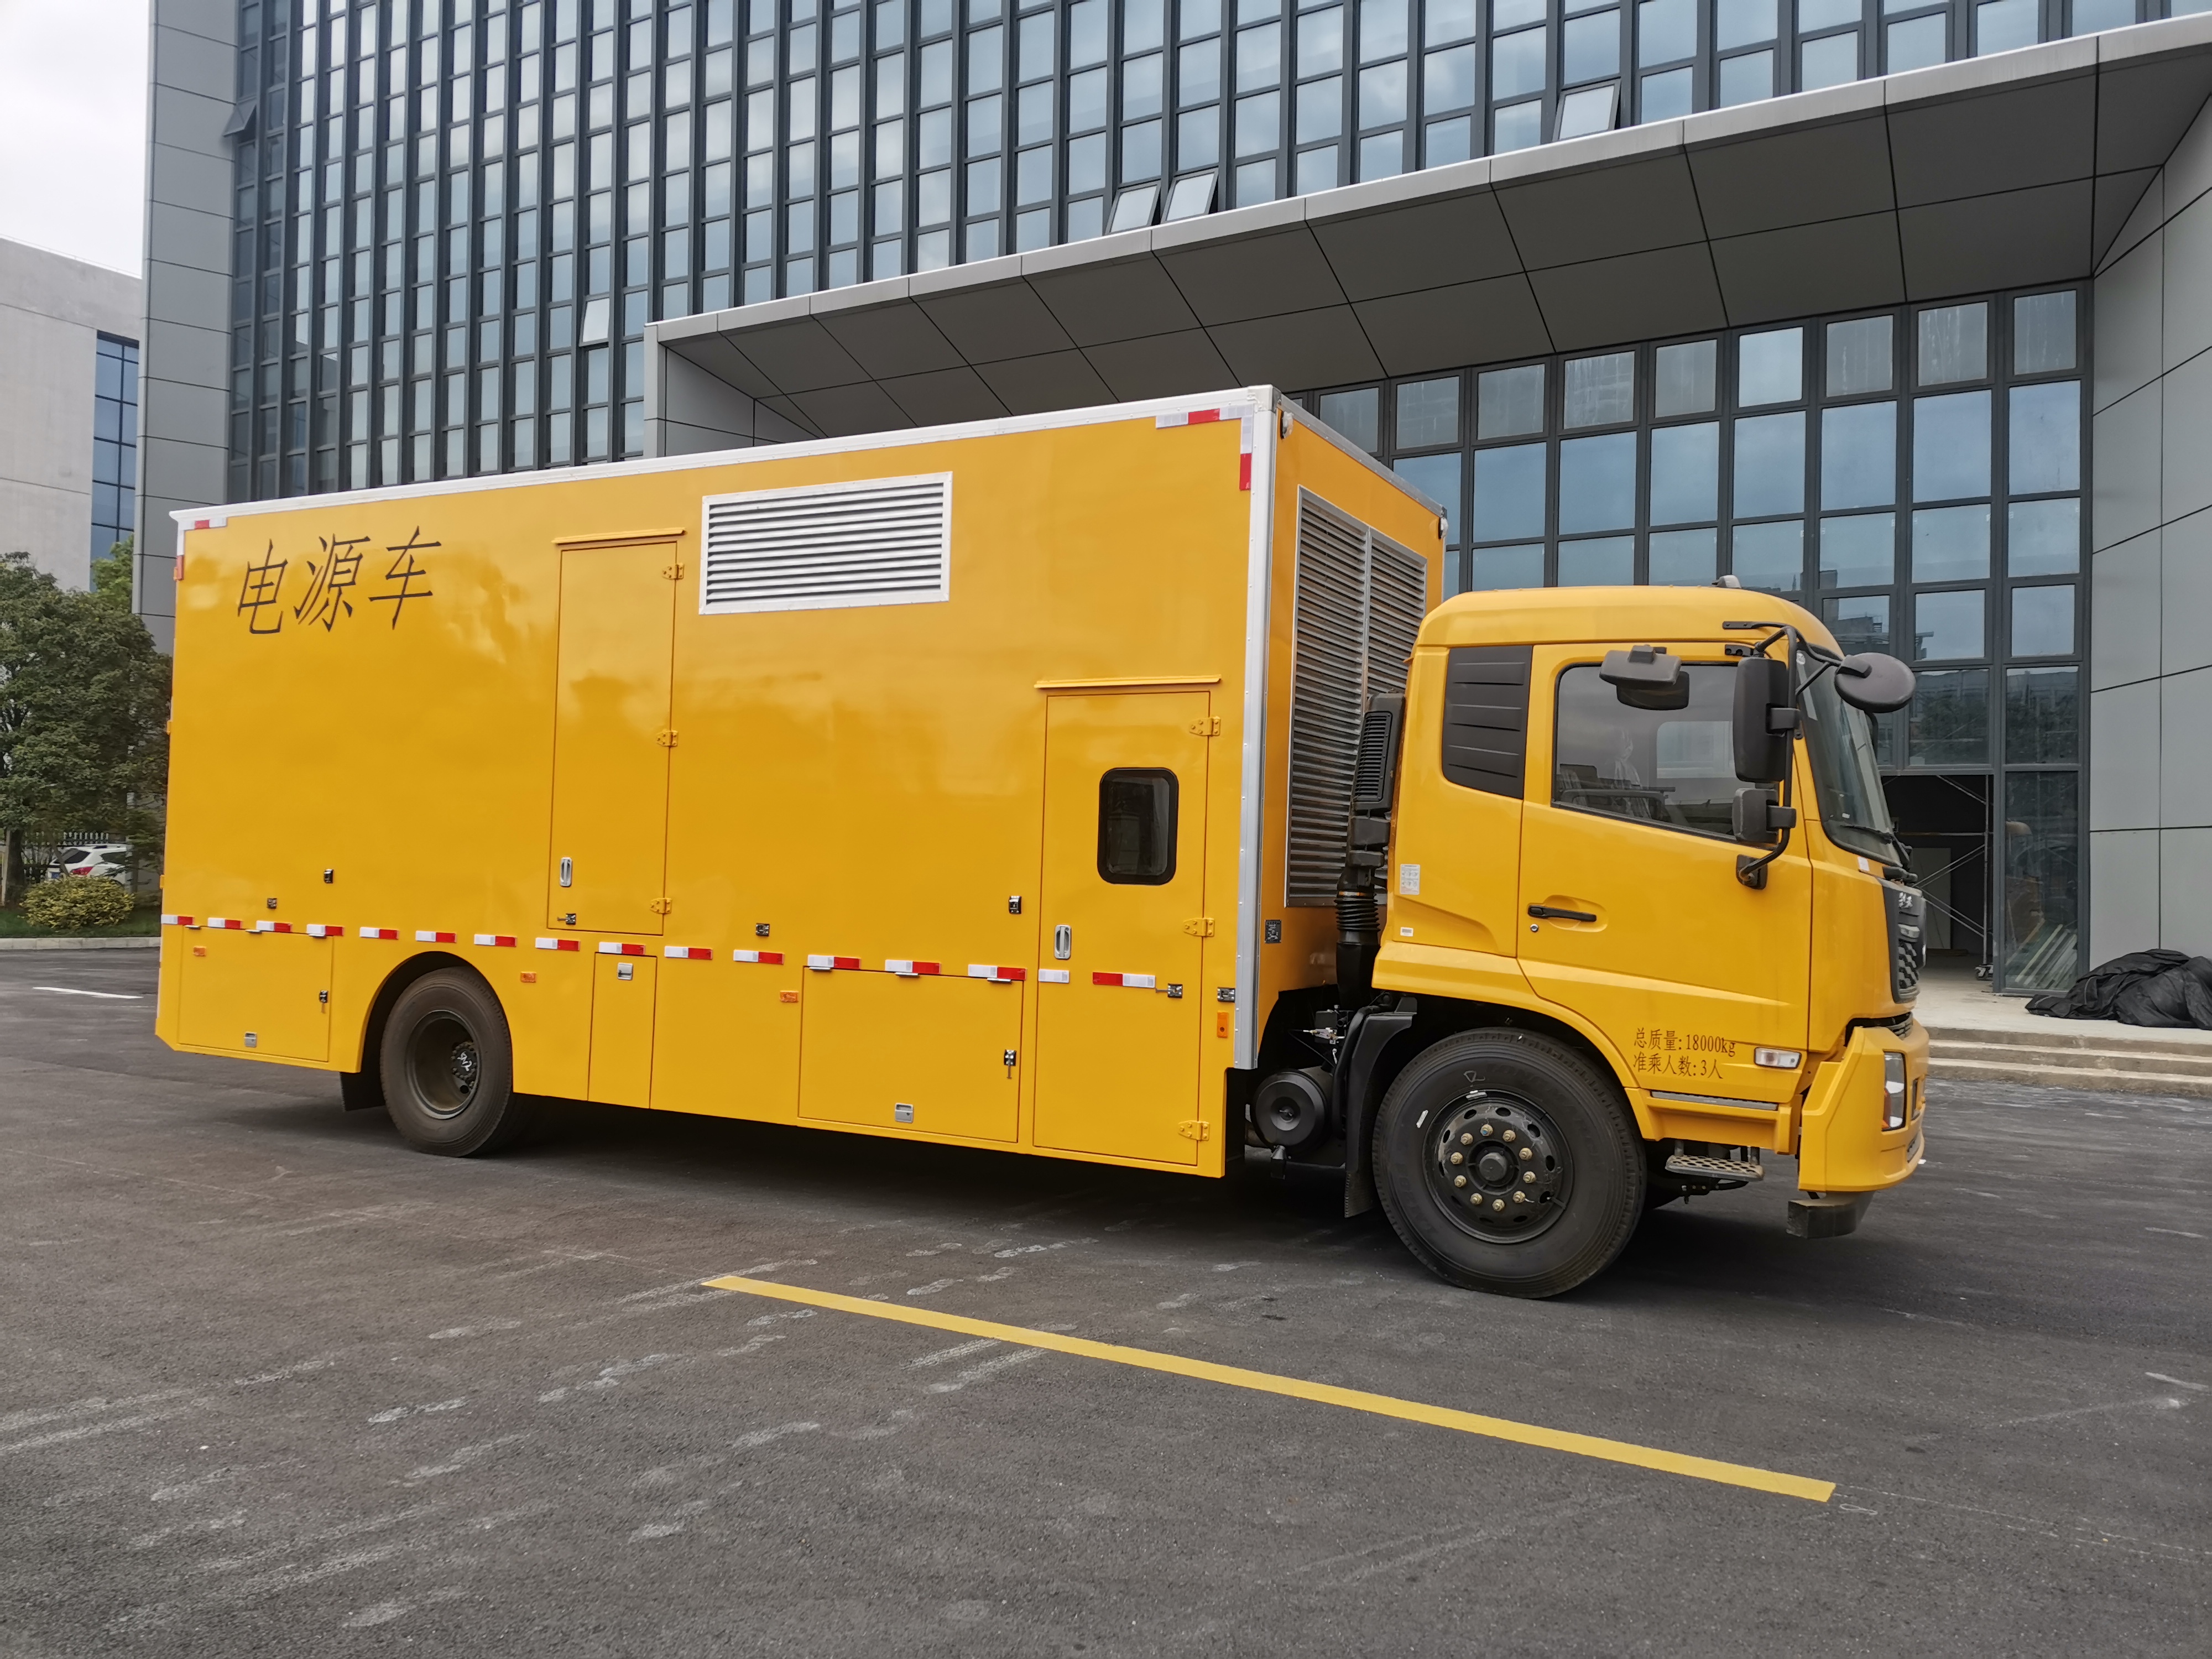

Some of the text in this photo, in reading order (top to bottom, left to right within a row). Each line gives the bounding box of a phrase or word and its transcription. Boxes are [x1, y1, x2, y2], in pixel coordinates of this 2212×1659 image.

[237, 525, 442, 634] 电源车
[1634, 1027, 1736, 1057] 总质量:18000kg
[1633, 1051, 1724, 1079] 准乘人数:3人
